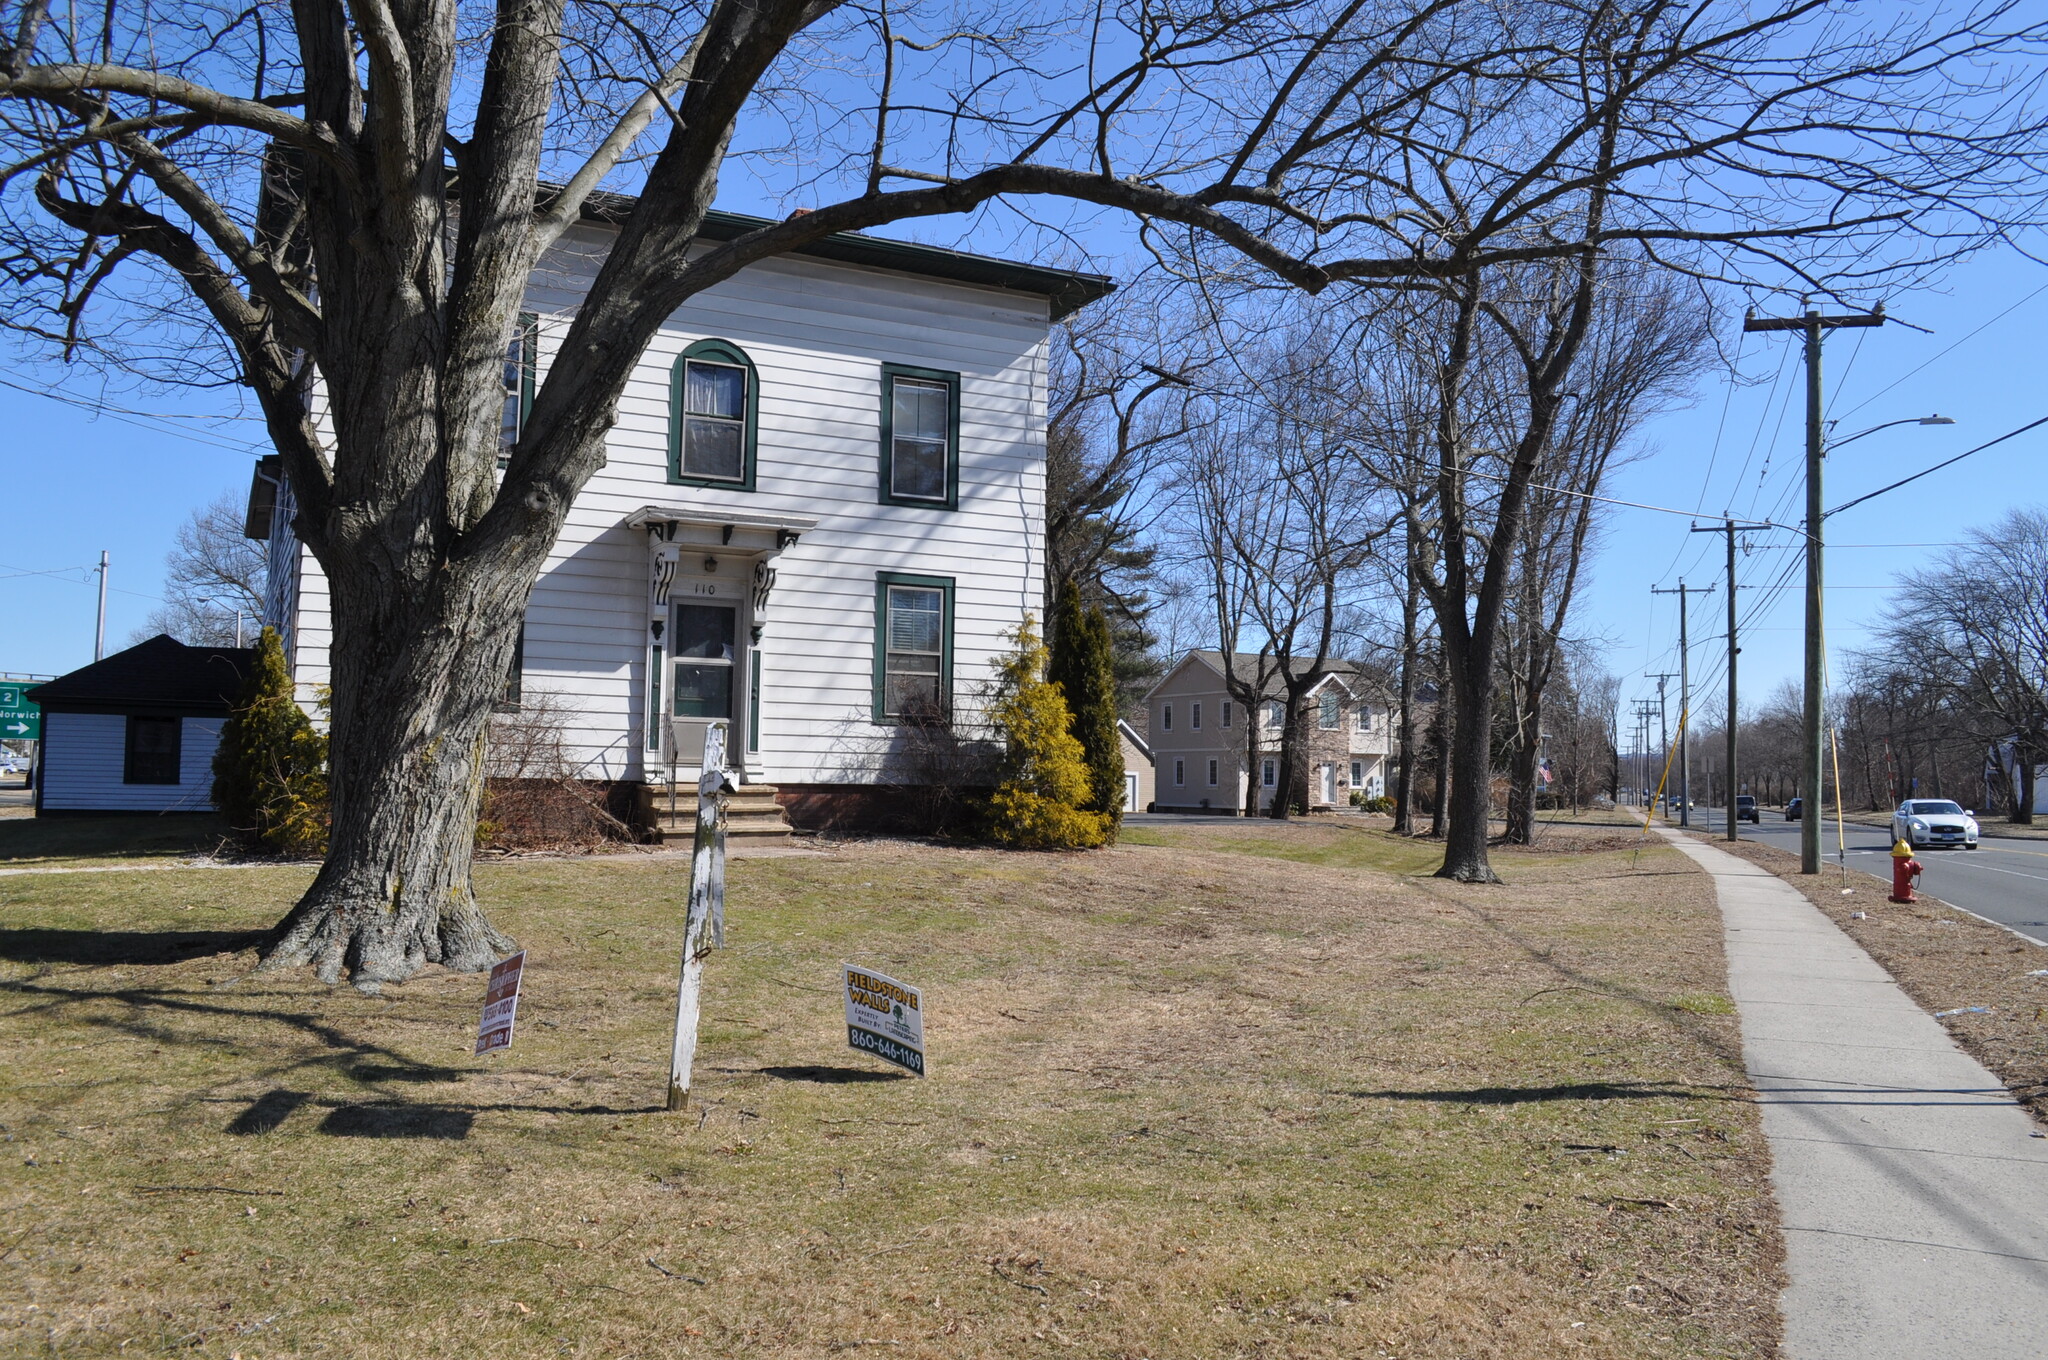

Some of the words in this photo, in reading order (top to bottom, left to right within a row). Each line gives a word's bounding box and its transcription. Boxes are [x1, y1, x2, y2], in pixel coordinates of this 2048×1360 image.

[695, 584, 715, 595] 110
[4, 692, 12, 702] 2
[847, 970, 918, 1011] FIELDSTONE
[848, 987, 890, 1014] WALLS
[851, 1029, 921, 1070] 860-646-1169
